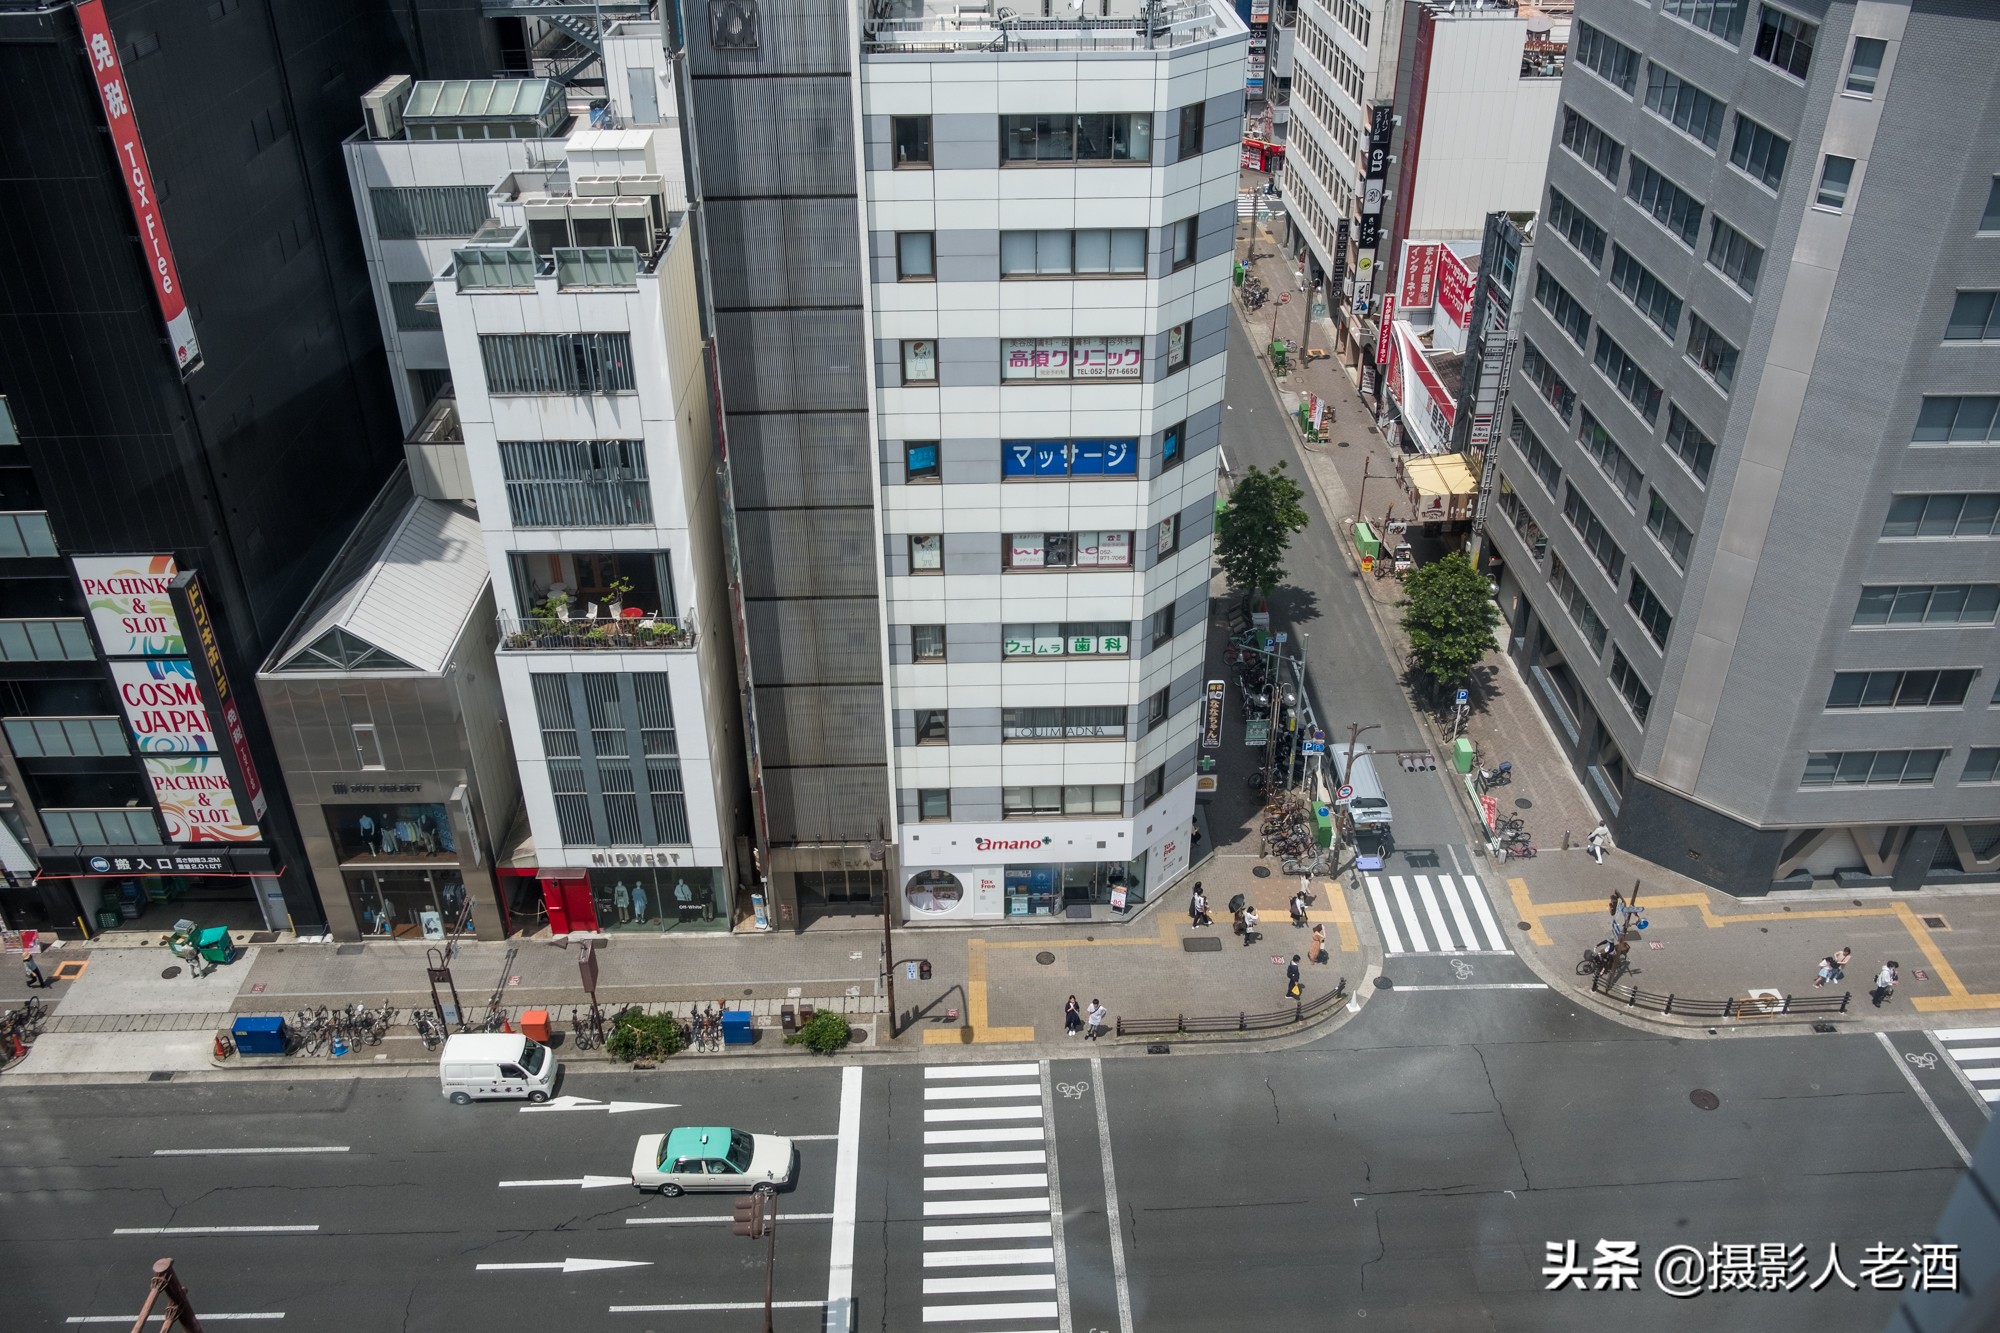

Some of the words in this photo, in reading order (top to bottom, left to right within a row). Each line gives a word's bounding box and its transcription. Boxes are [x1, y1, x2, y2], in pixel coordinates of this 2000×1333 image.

[91, 33, 127, 119] 免税
[1371, 148, 1384, 172] en
[124, 142, 149, 207] Tax
[145, 214, 173, 294] Free
[1405, 246, 1421, 306] インターネット
[1009, 349, 1141, 367] 高須クリニック
[1169, 353, 1179, 364] 7F
[1012, 443, 1128, 468] マッサージ
[132, 598, 147, 614] &
[122, 617, 167, 634] SLOT
[1267, 638, 1274, 647] P
[1459, 691, 1467, 699] P
[1305, 742, 1313, 751] P
[198, 793, 212, 807] &
[188, 810, 230, 824] SLOT
[976, 838, 1042, 851] amano
[114, 858, 173, 870] 搬入口
[591, 852, 681, 866] MIDWEST
